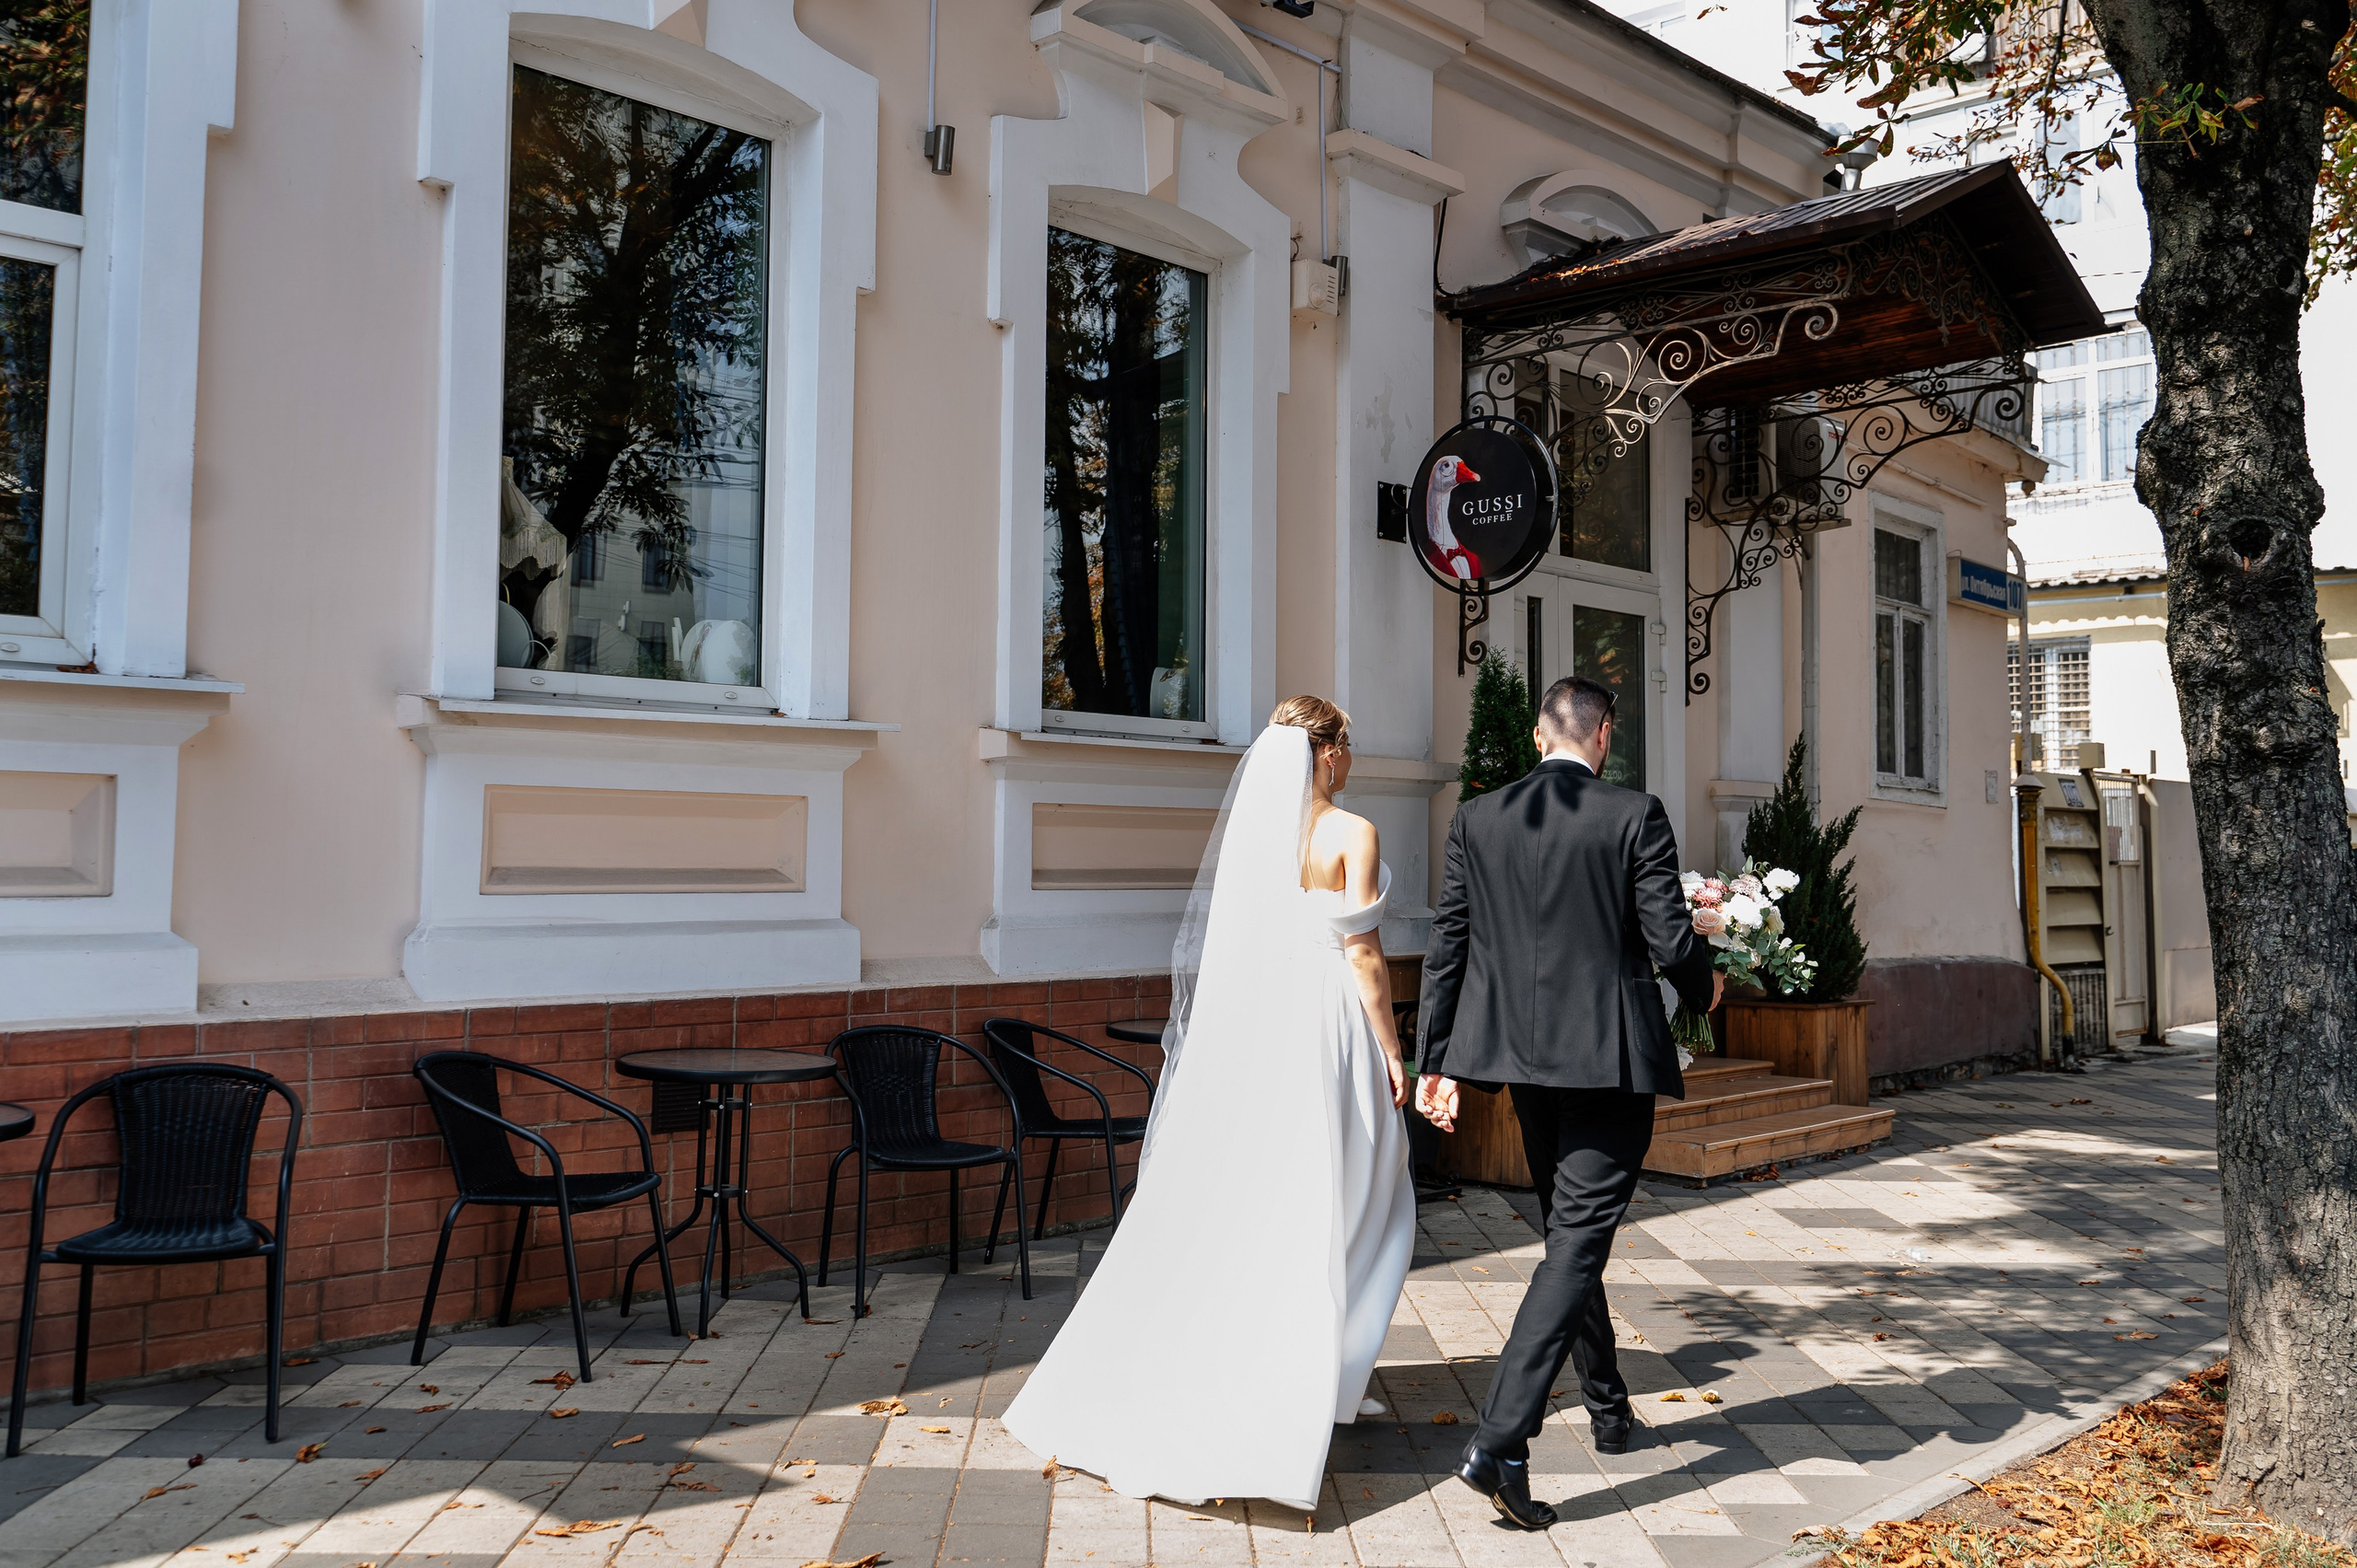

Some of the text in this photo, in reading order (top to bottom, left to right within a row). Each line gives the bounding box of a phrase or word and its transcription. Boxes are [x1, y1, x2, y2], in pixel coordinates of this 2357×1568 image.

[1462, 494, 1522, 516] GUSSI
[1472, 513, 1513, 526] COFFEE
[2008, 580, 2022, 610] 107
